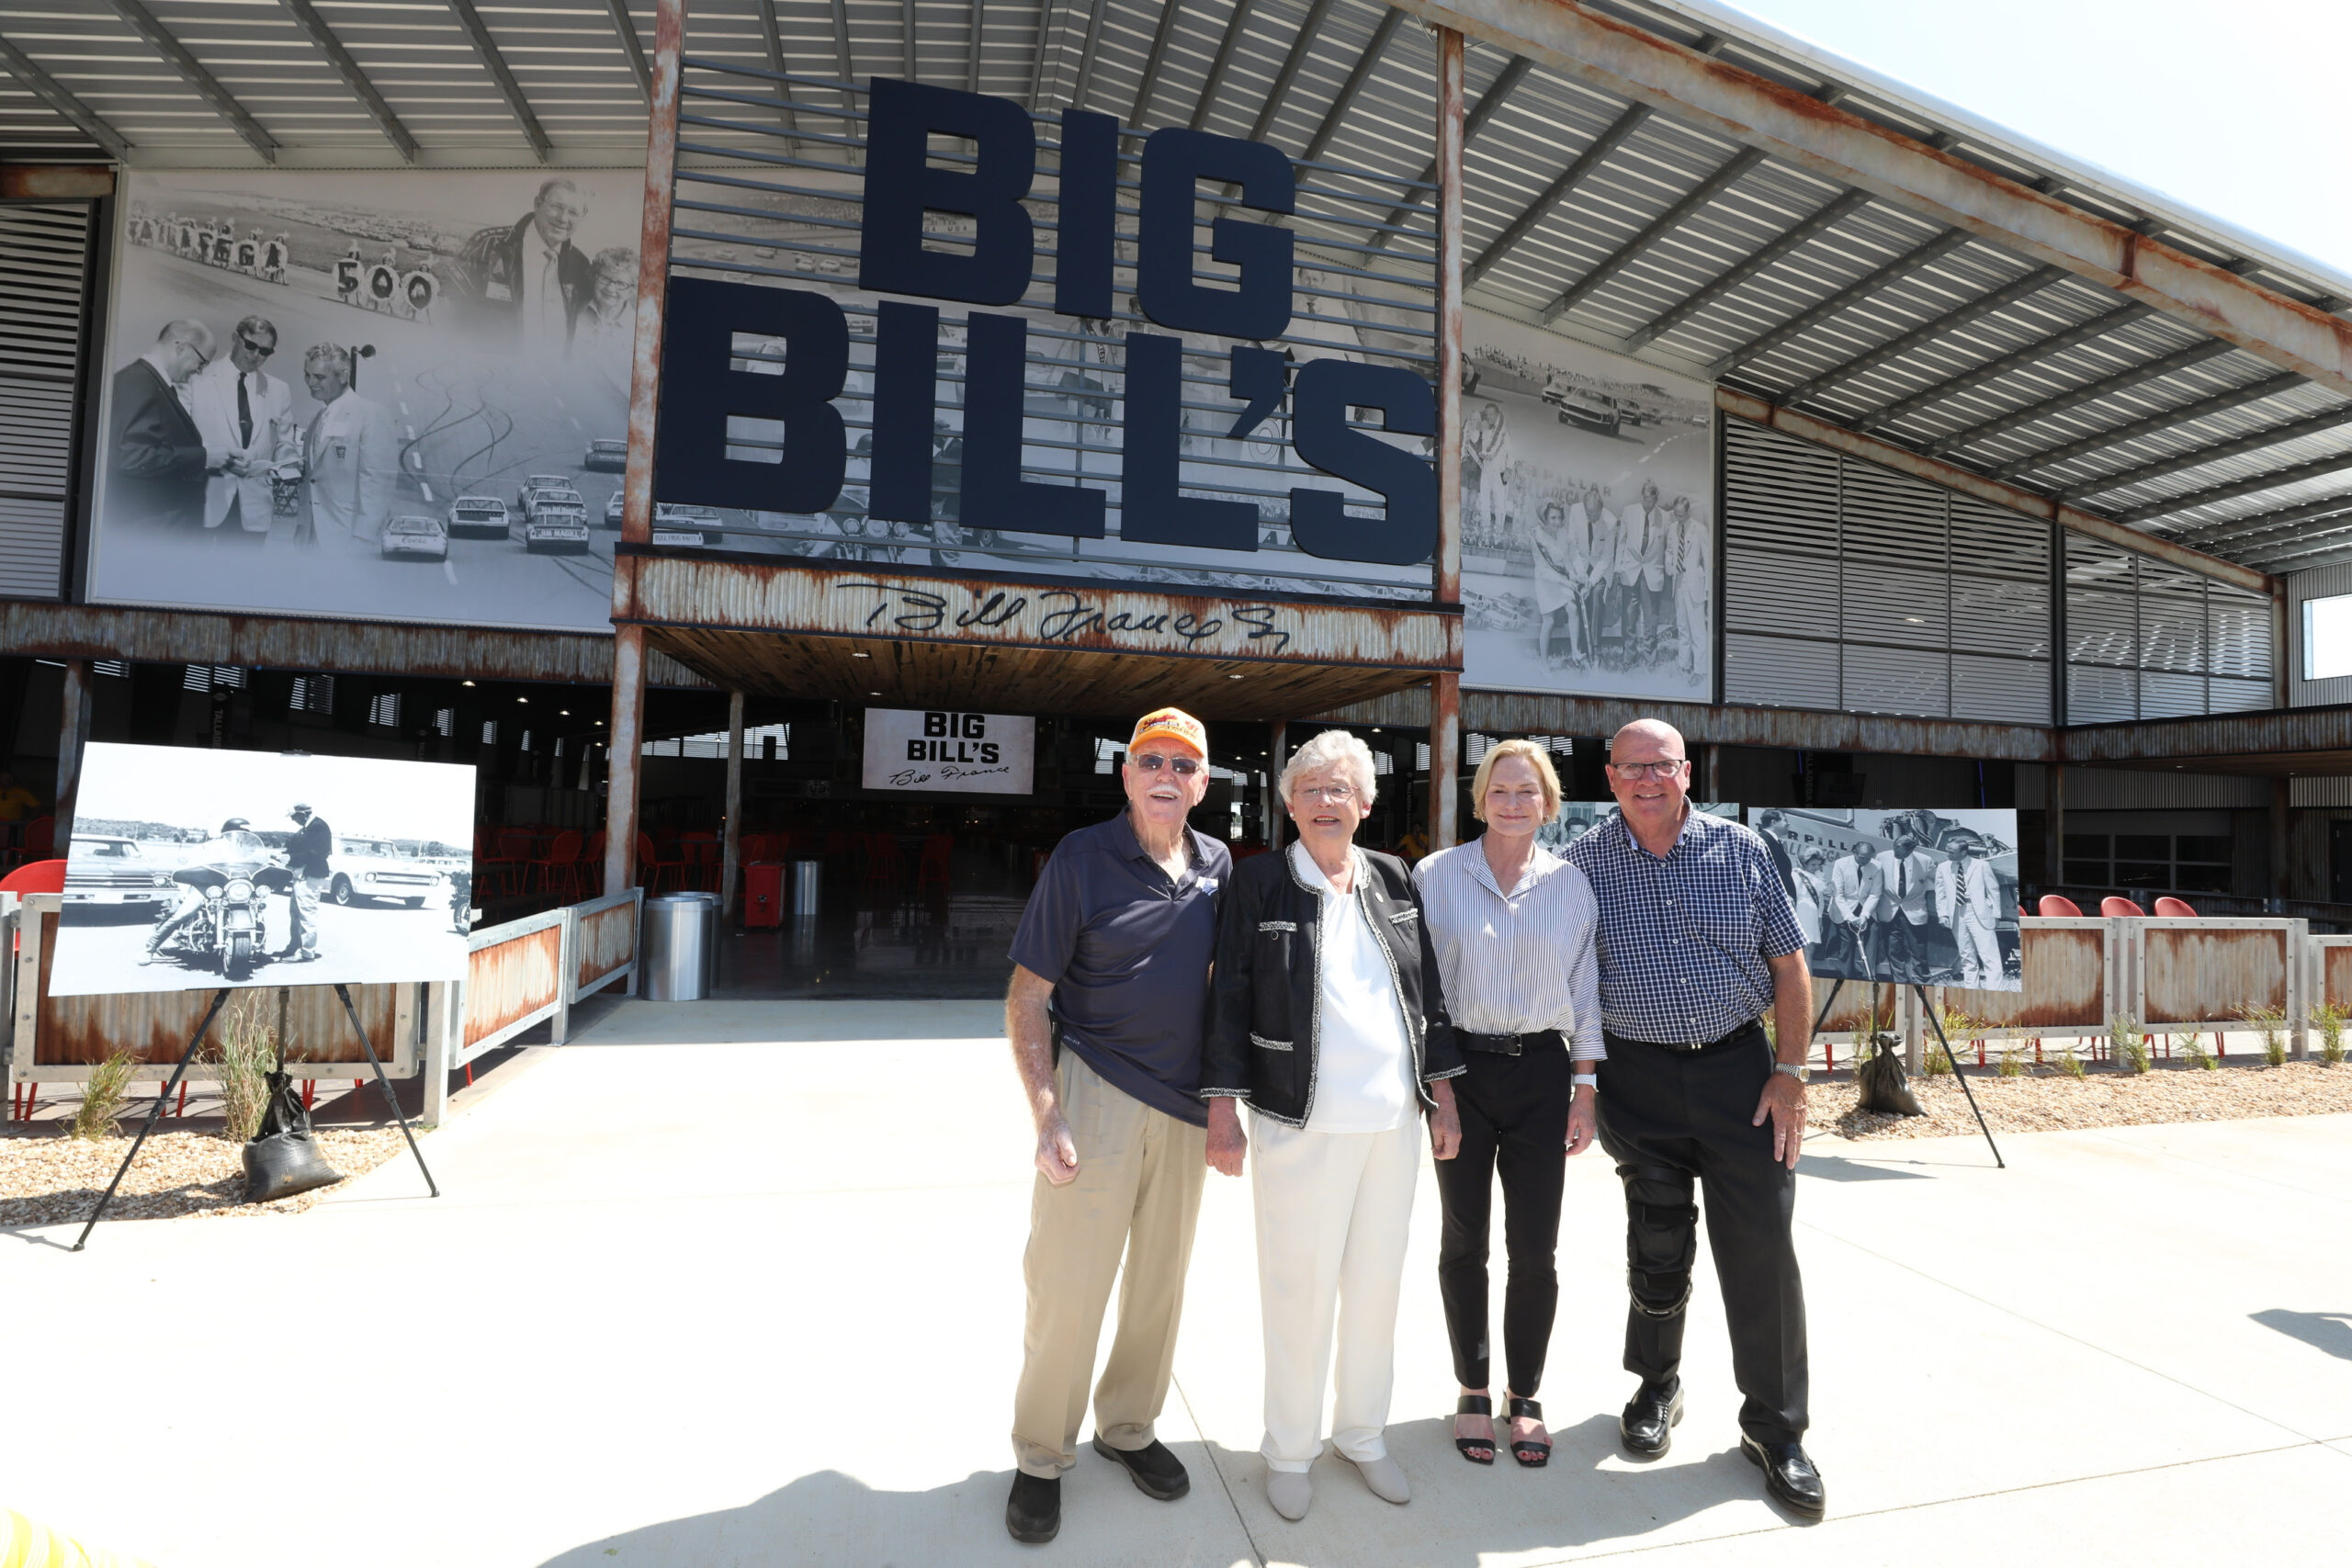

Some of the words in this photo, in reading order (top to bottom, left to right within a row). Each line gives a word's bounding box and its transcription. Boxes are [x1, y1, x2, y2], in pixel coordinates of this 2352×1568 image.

[861, 75, 1295, 342] BIG
[338, 262, 432, 309] 500
[655, 276, 1438, 566] BILL'S
[837, 584, 1026, 631] Bill
[924, 712, 985, 739] BIG
[907, 739, 999, 764] BILL'S
[889, 769, 931, 785] Bill
[941, 766, 1010, 781] France
